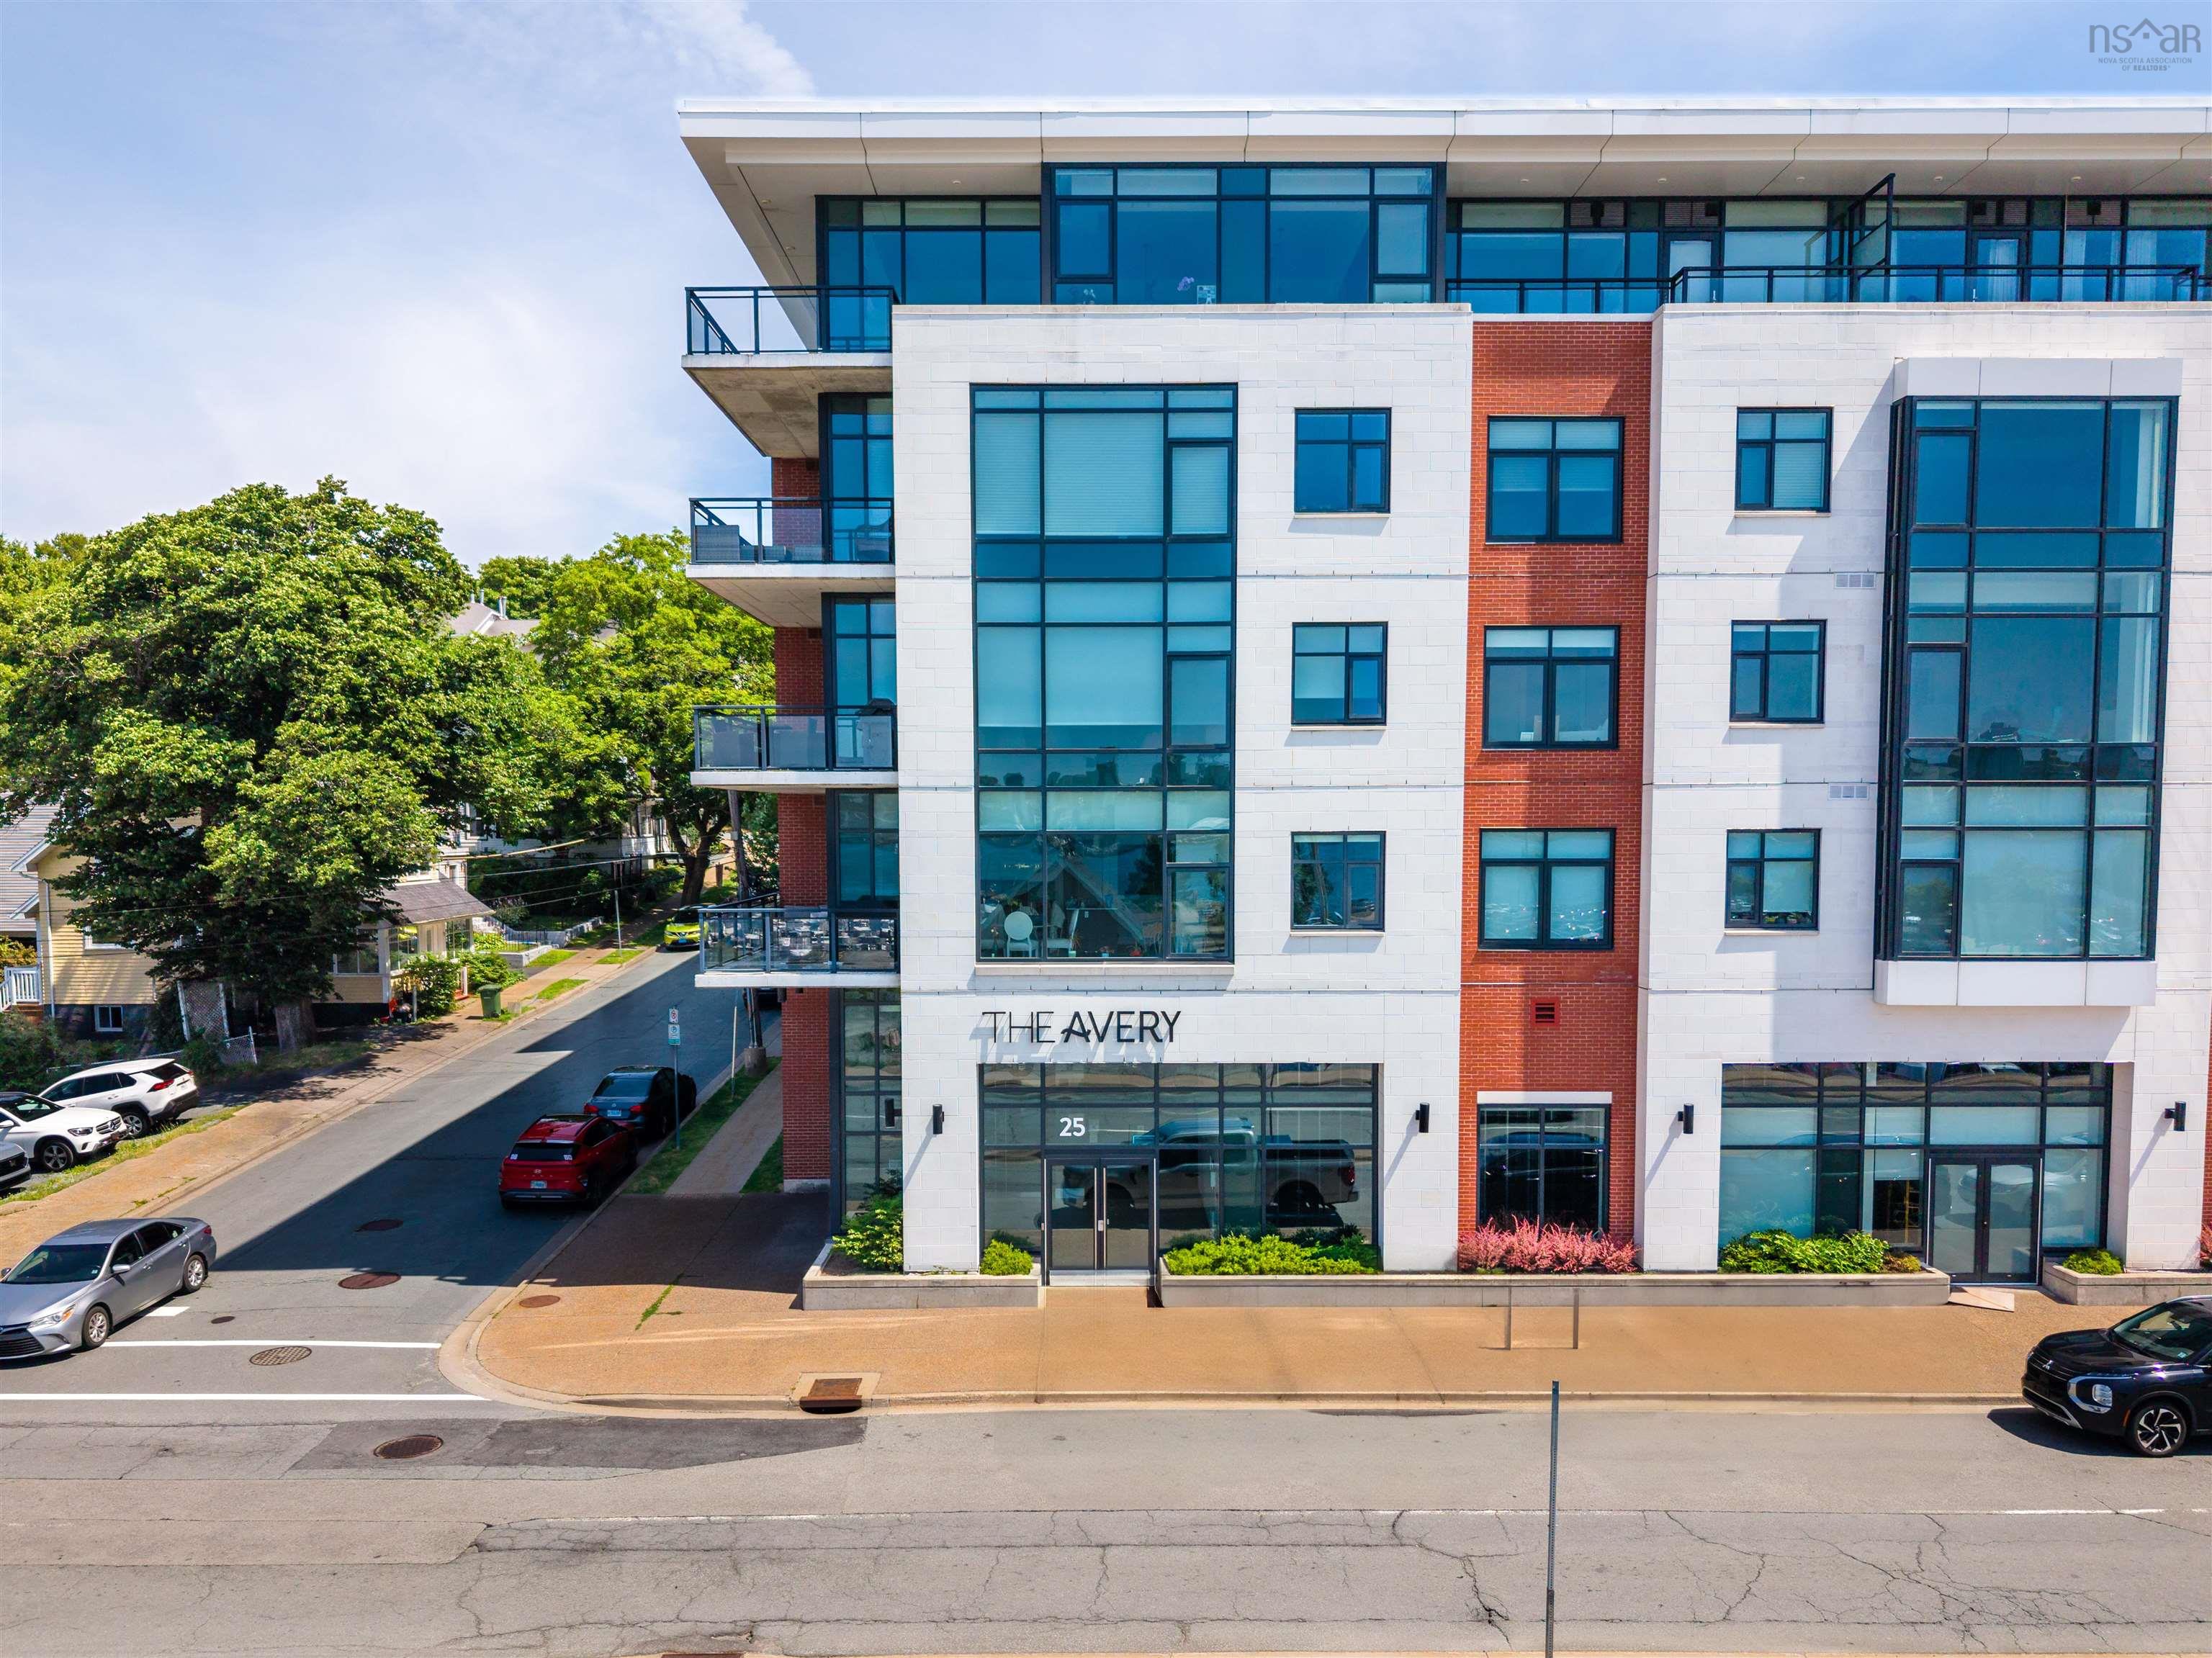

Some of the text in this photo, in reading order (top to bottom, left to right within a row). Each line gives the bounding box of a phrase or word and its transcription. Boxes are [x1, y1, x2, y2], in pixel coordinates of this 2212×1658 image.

[981, 1010, 1182, 1043] THE AVERY
[1059, 1117, 1086, 1137] 25
